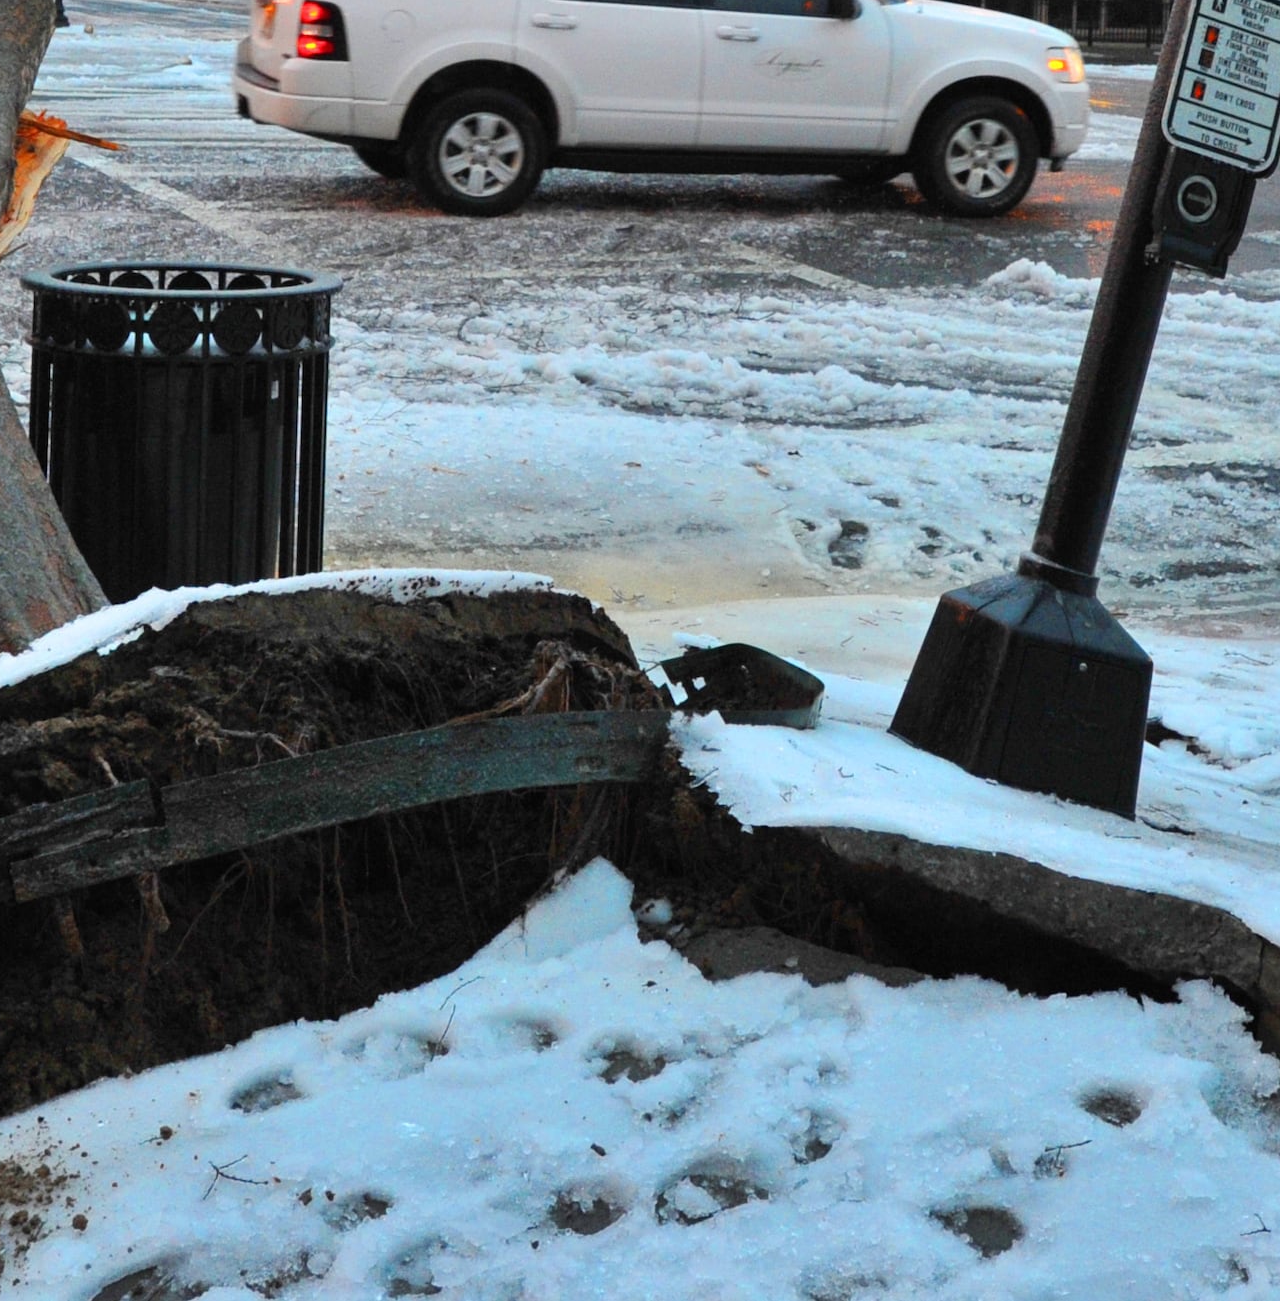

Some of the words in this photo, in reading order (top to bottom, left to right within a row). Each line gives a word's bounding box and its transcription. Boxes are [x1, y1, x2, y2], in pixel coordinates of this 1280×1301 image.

[1215, 91, 1234, 103] DON'T
[1235, 98, 1256, 111] CROSS
[1196, 112, 1218, 125] PUSH
[1220, 119, 1250, 135] BUTTON
[1200, 134, 1210, 143] TO
[1212, 138, 1239, 152] CROSS
